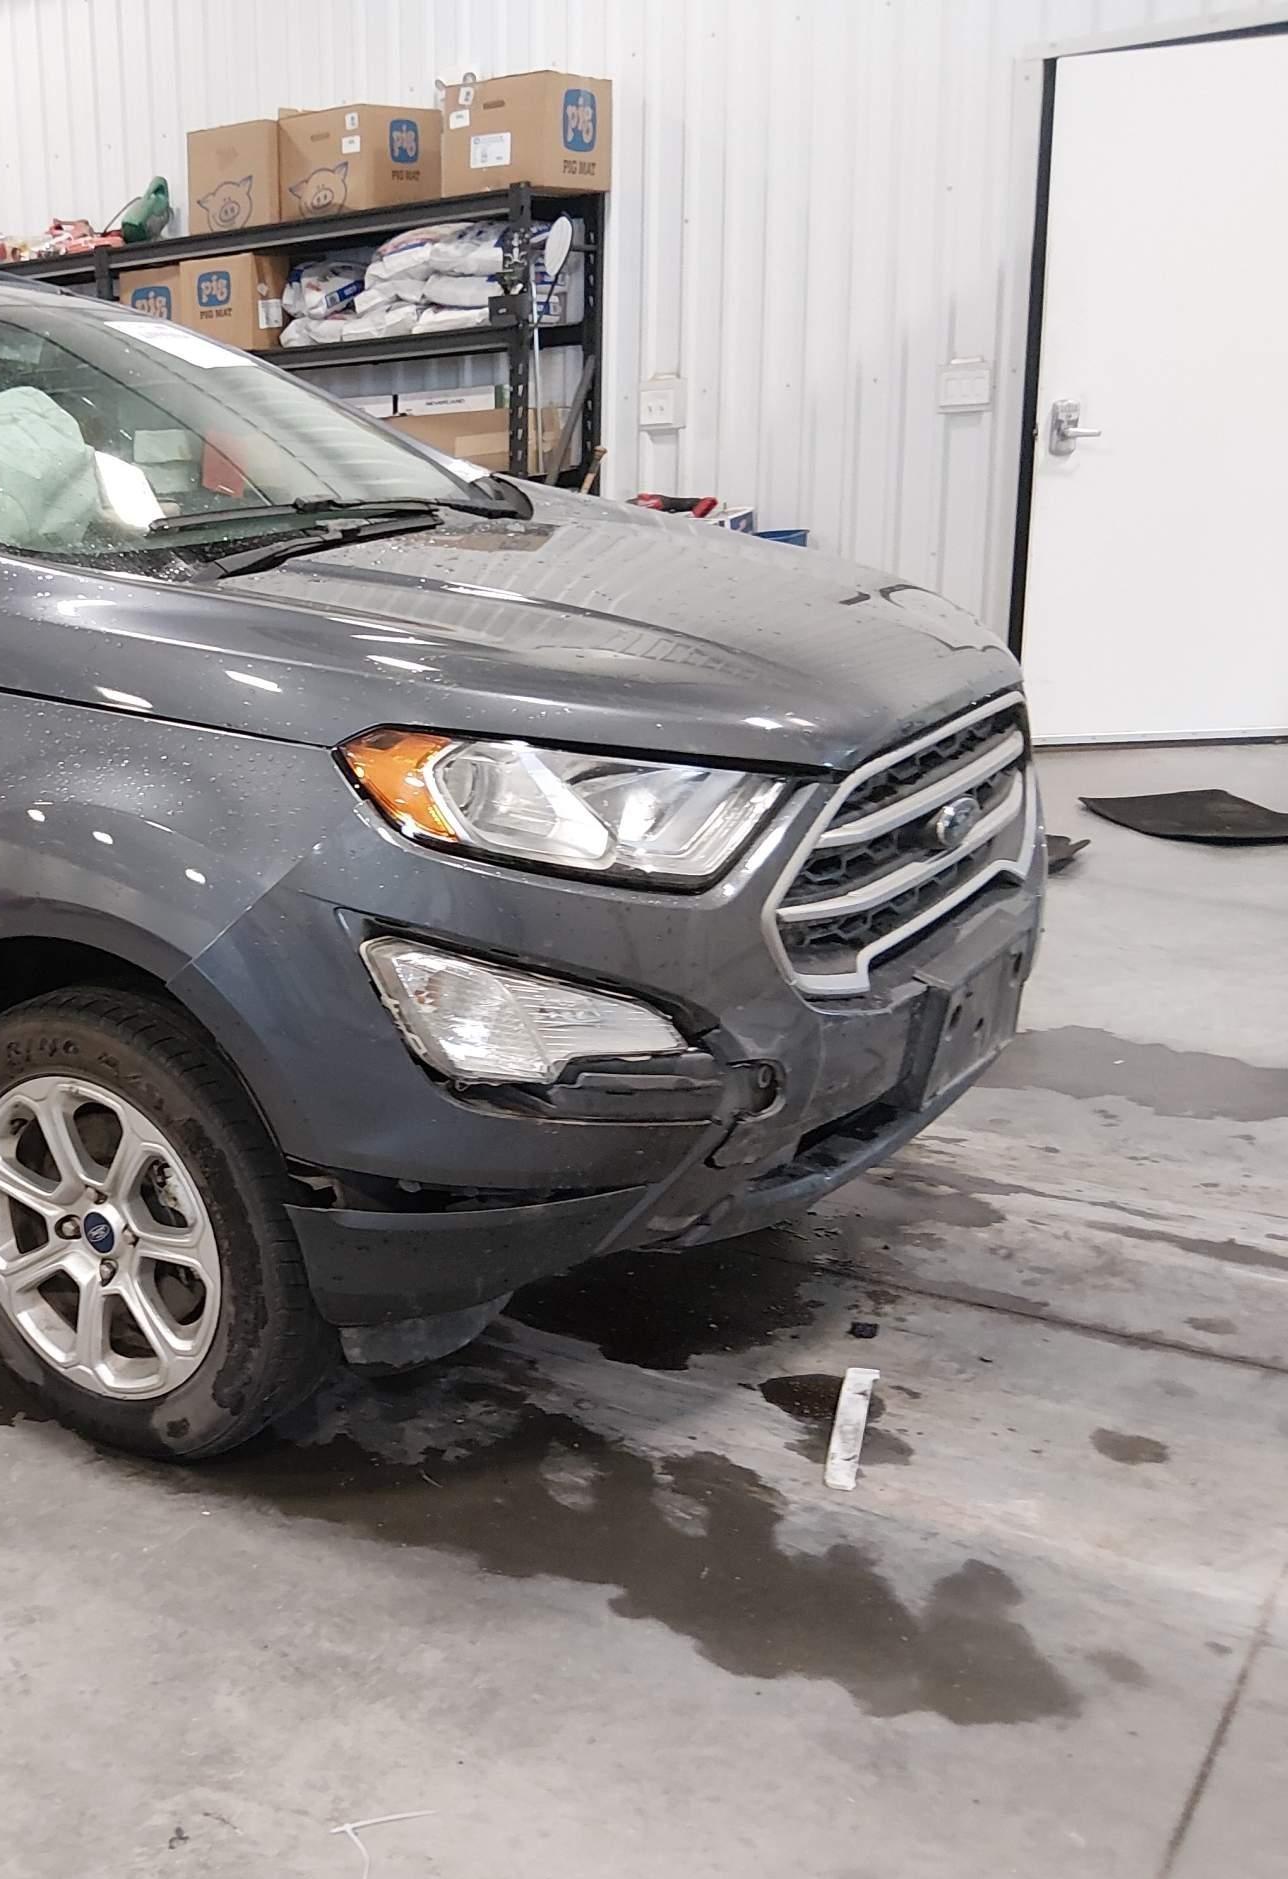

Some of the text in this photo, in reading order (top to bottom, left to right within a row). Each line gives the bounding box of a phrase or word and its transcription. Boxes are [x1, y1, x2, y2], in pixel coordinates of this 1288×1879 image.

[567, 96, 593, 144] pig
[393, 123, 417, 158] pig
[562, 160, 597, 177] PIG MAT
[200, 274, 229, 304] pig
[199, 308, 233, 320] PIG MAT
